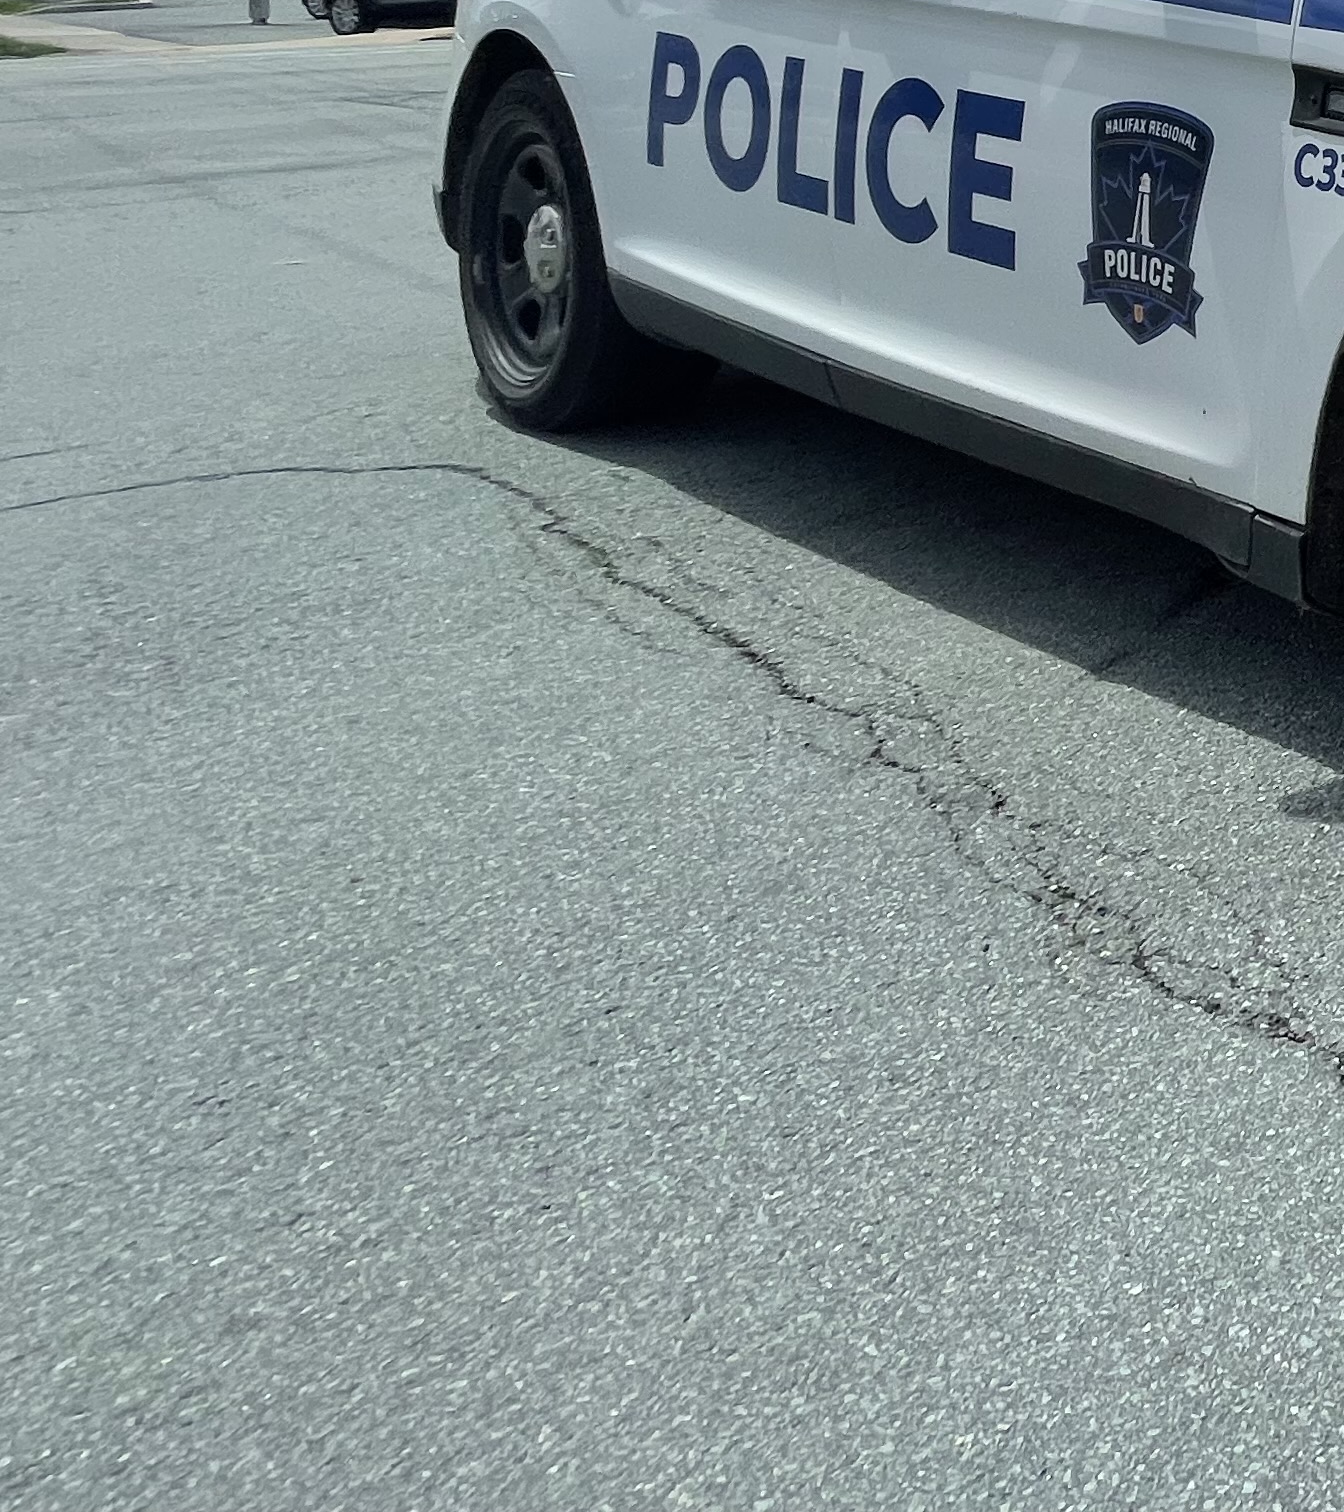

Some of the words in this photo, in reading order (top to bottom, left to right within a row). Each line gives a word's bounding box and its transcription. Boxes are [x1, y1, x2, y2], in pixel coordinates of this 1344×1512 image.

[647, 31, 1026, 272] POLICE
[1105, 118, 1147, 134] HALIFAX
[1148, 120, 1197, 151] REGIONAL
[1104, 249, 1175, 294] POLICE
